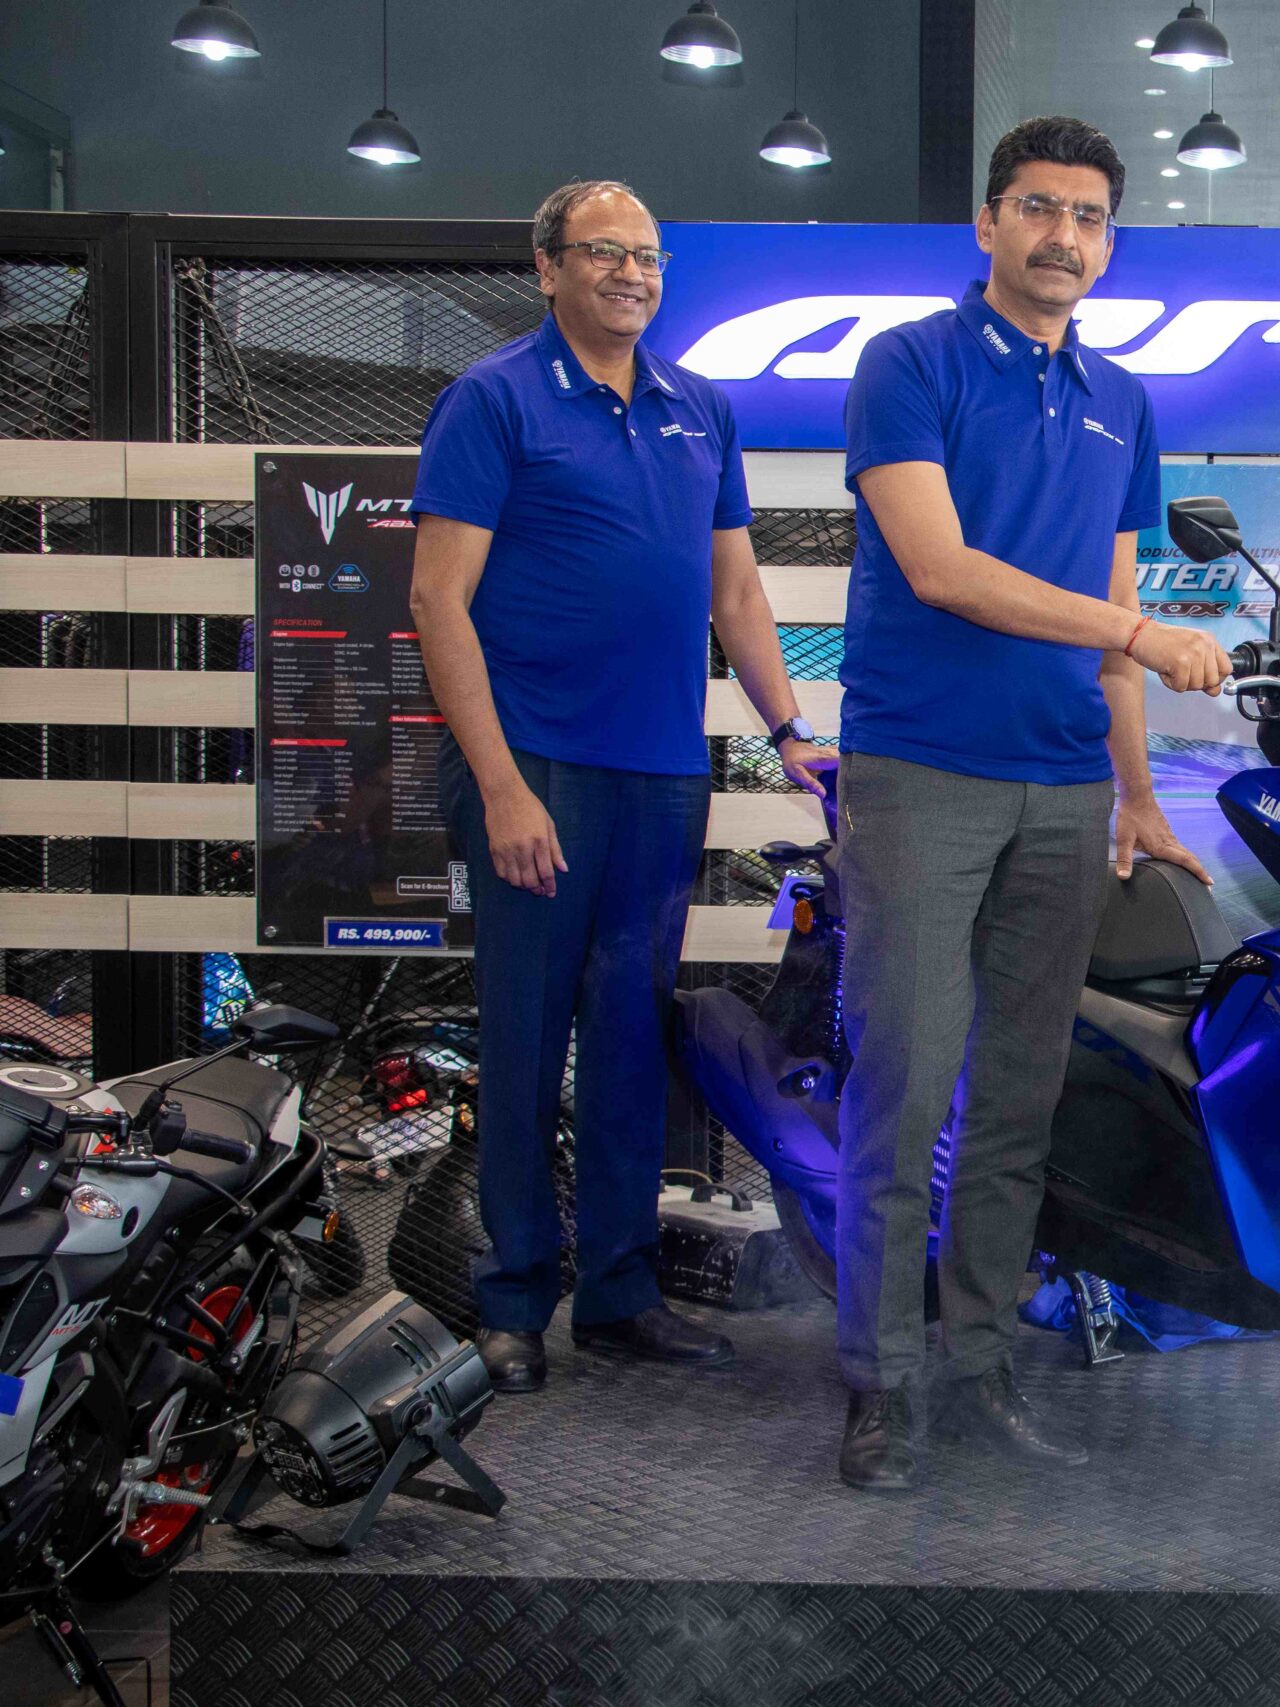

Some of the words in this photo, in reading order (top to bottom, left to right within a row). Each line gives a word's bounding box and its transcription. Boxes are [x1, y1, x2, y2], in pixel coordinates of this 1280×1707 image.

[337, 575, 361, 583] YAMAHA
[400, 882, 413, 890] Scan
[338, 928, 360, 941] RS.
[364, 929, 431, 943] 499,900/-
